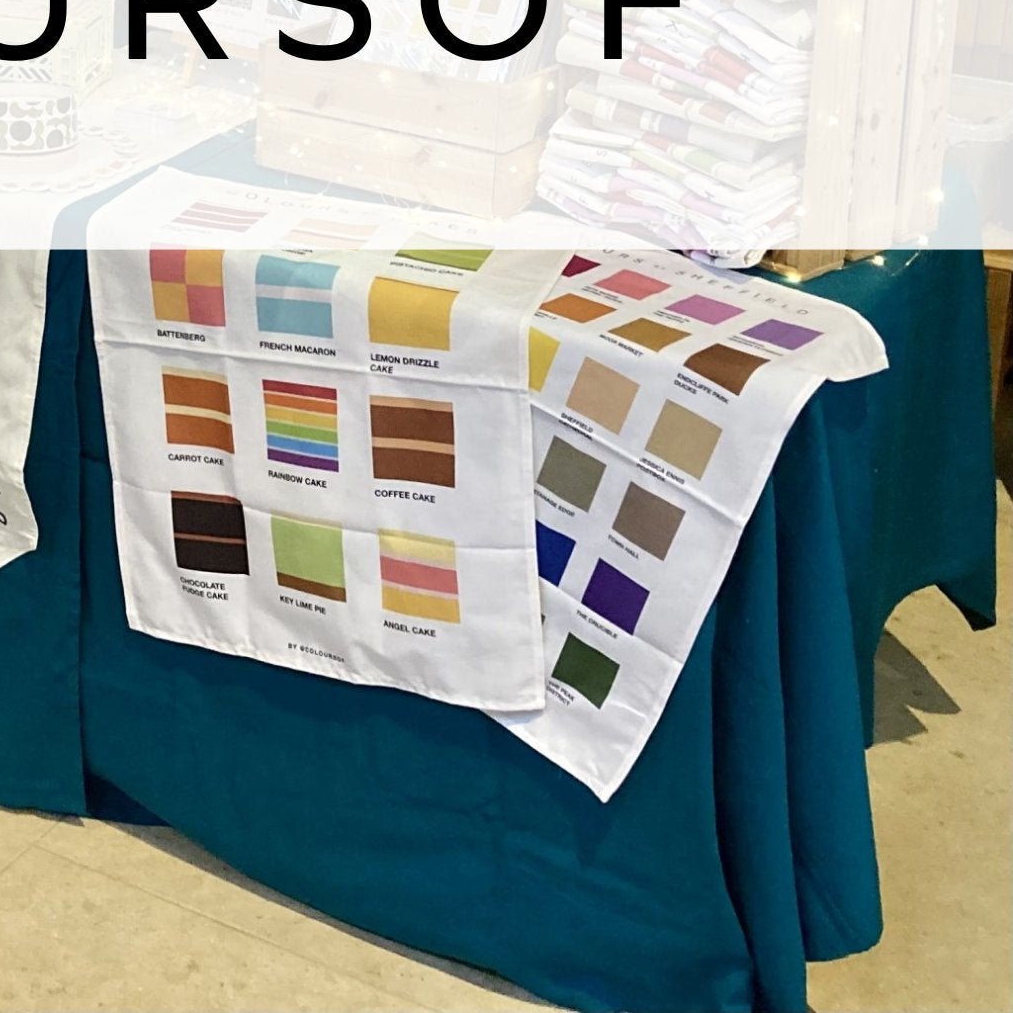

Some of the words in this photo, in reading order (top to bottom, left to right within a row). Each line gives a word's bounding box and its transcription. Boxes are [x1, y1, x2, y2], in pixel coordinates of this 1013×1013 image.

[674, 270, 809, 316] SHEFFIELD
[157, 329, 206, 342] BATTENBERG
[259, 341, 292, 352] FRENCH
[294, 346, 336, 356] MACARON
[617, 341, 644, 357] MARKET
[370, 353, 401, 364] LEMON
[403, 357, 439, 369] DRIZZLE
[370, 365, 393, 374] CAKE
[674, 380, 698, 395] DUCKS
[677, 372, 712, 395] ENDCLIFFE
[712, 390, 729, 404] PARK
[561, 413, 594, 433] SHEFFIELD
[168, 453, 201, 463] CARROT
[203, 456, 225, 466] CAKE
[268, 470, 303, 484] RAINBOW
[304, 477, 327, 488] CAKE
[639, 457, 665, 473] JESSICA
[666, 470, 685, 485] ENNIS
[374, 489, 411, 501] COFFEE
[412, 492, 436, 504] CAKE
[558, 506, 575, 517] EDGE
[608, 535, 624, 549] TOWN
[625, 546, 639, 559] HALL
[179, 576, 226, 590] CHOCOLATE
[181, 585, 205, 598] FUDGE
[206, 590, 229, 601] CAKE
[279, 595, 295, 605] KEY
[295, 599, 313, 610] LIME
[314, 605, 326, 615] PIE
[383, 620, 410, 634] ANGEL
[411, 625, 436, 638] CAKE
[576, 610, 588, 620] THE
[588, 617, 618, 639] CRUCIBLE
[560, 687, 575, 702] PEAK
